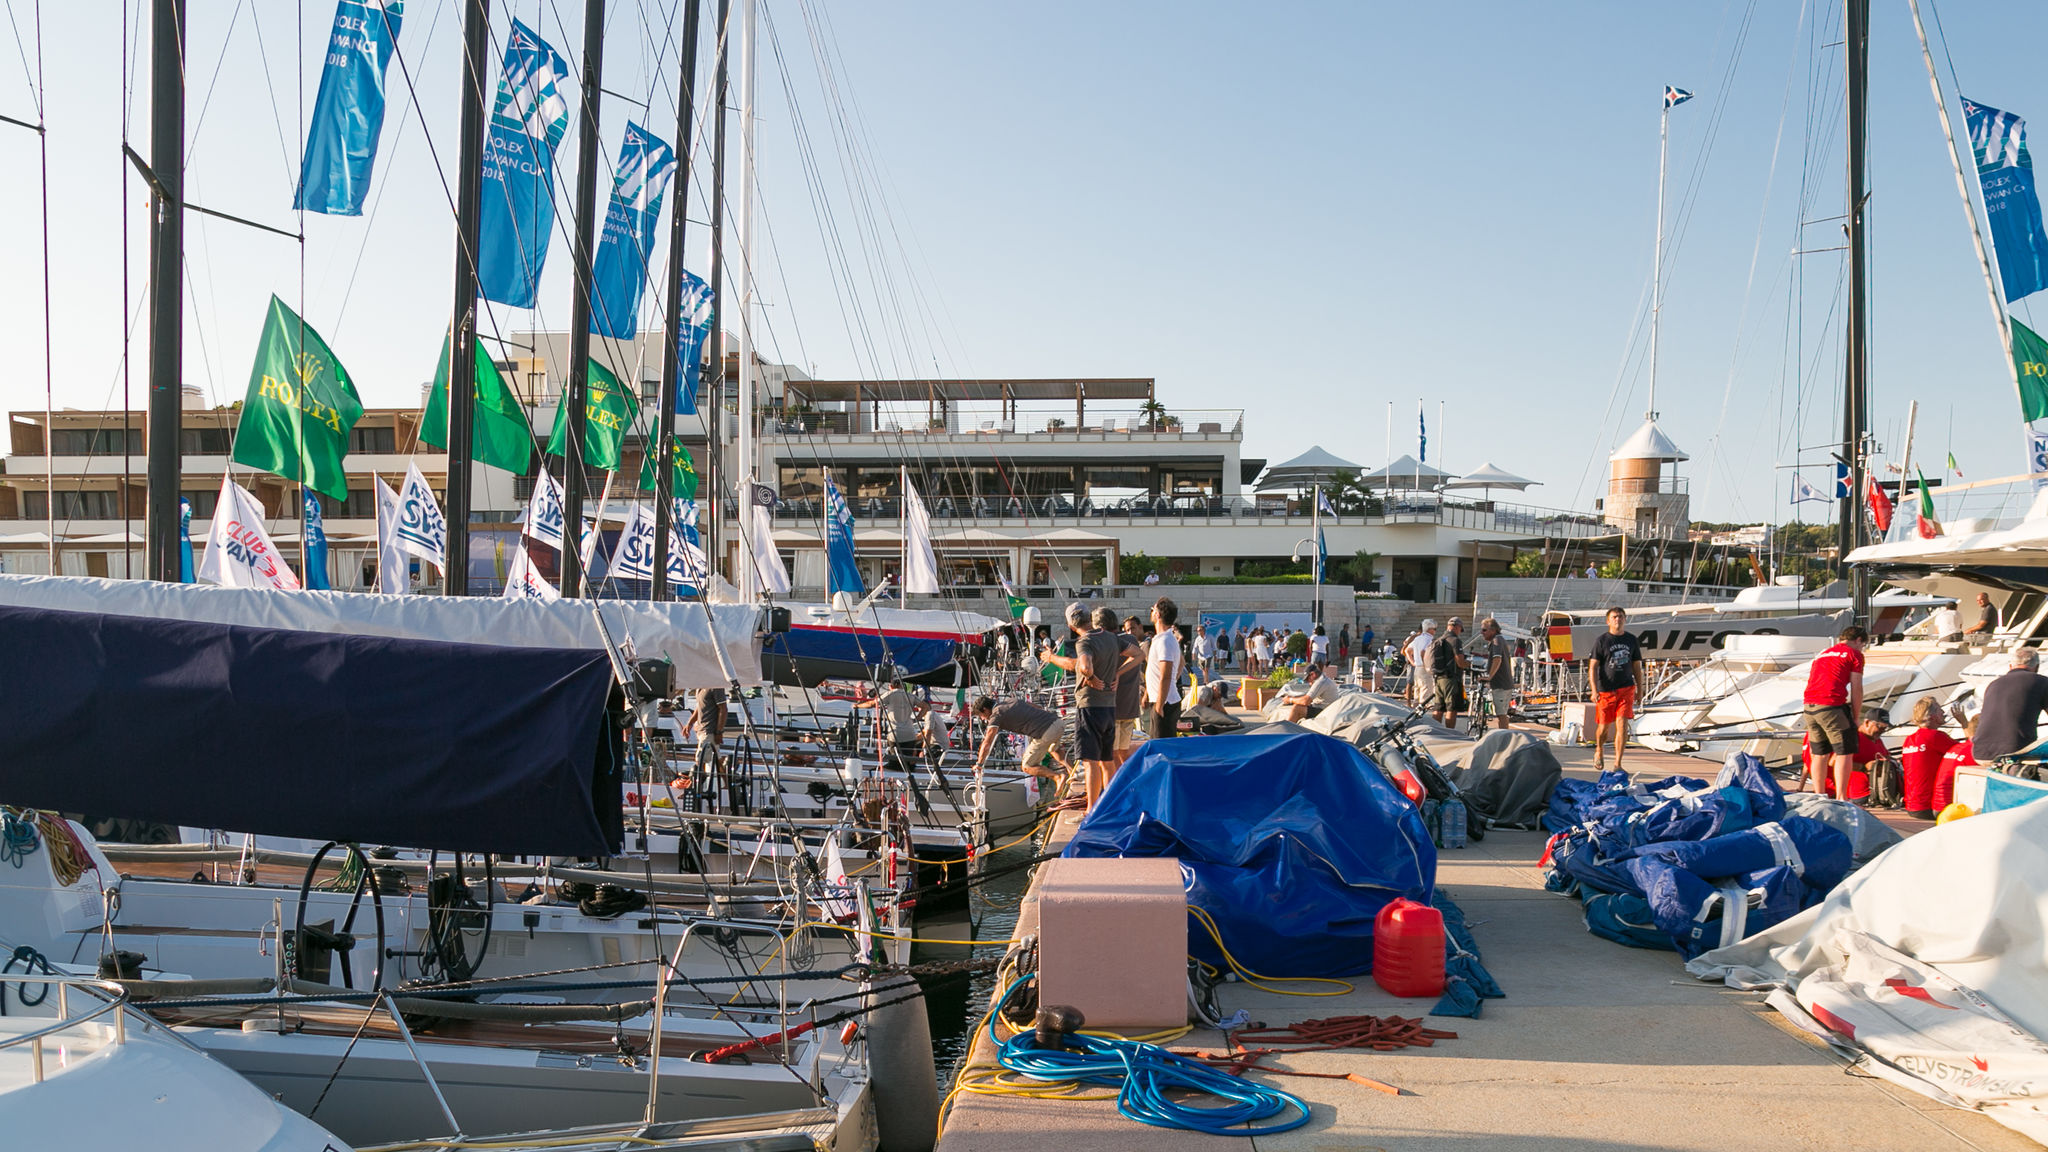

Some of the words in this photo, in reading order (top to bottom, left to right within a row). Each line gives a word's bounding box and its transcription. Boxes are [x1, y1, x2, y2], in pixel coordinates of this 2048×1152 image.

[332, 33, 361, 51] WAN
[328, 53, 348, 67] 018
[483, 150, 518, 169] SWAN
[1984, 187, 2012, 201] WAN
[1987, 201, 2007, 213] 018
[586, 404, 623, 431] LEX
[1637, 628, 1780, 650] AIFO
